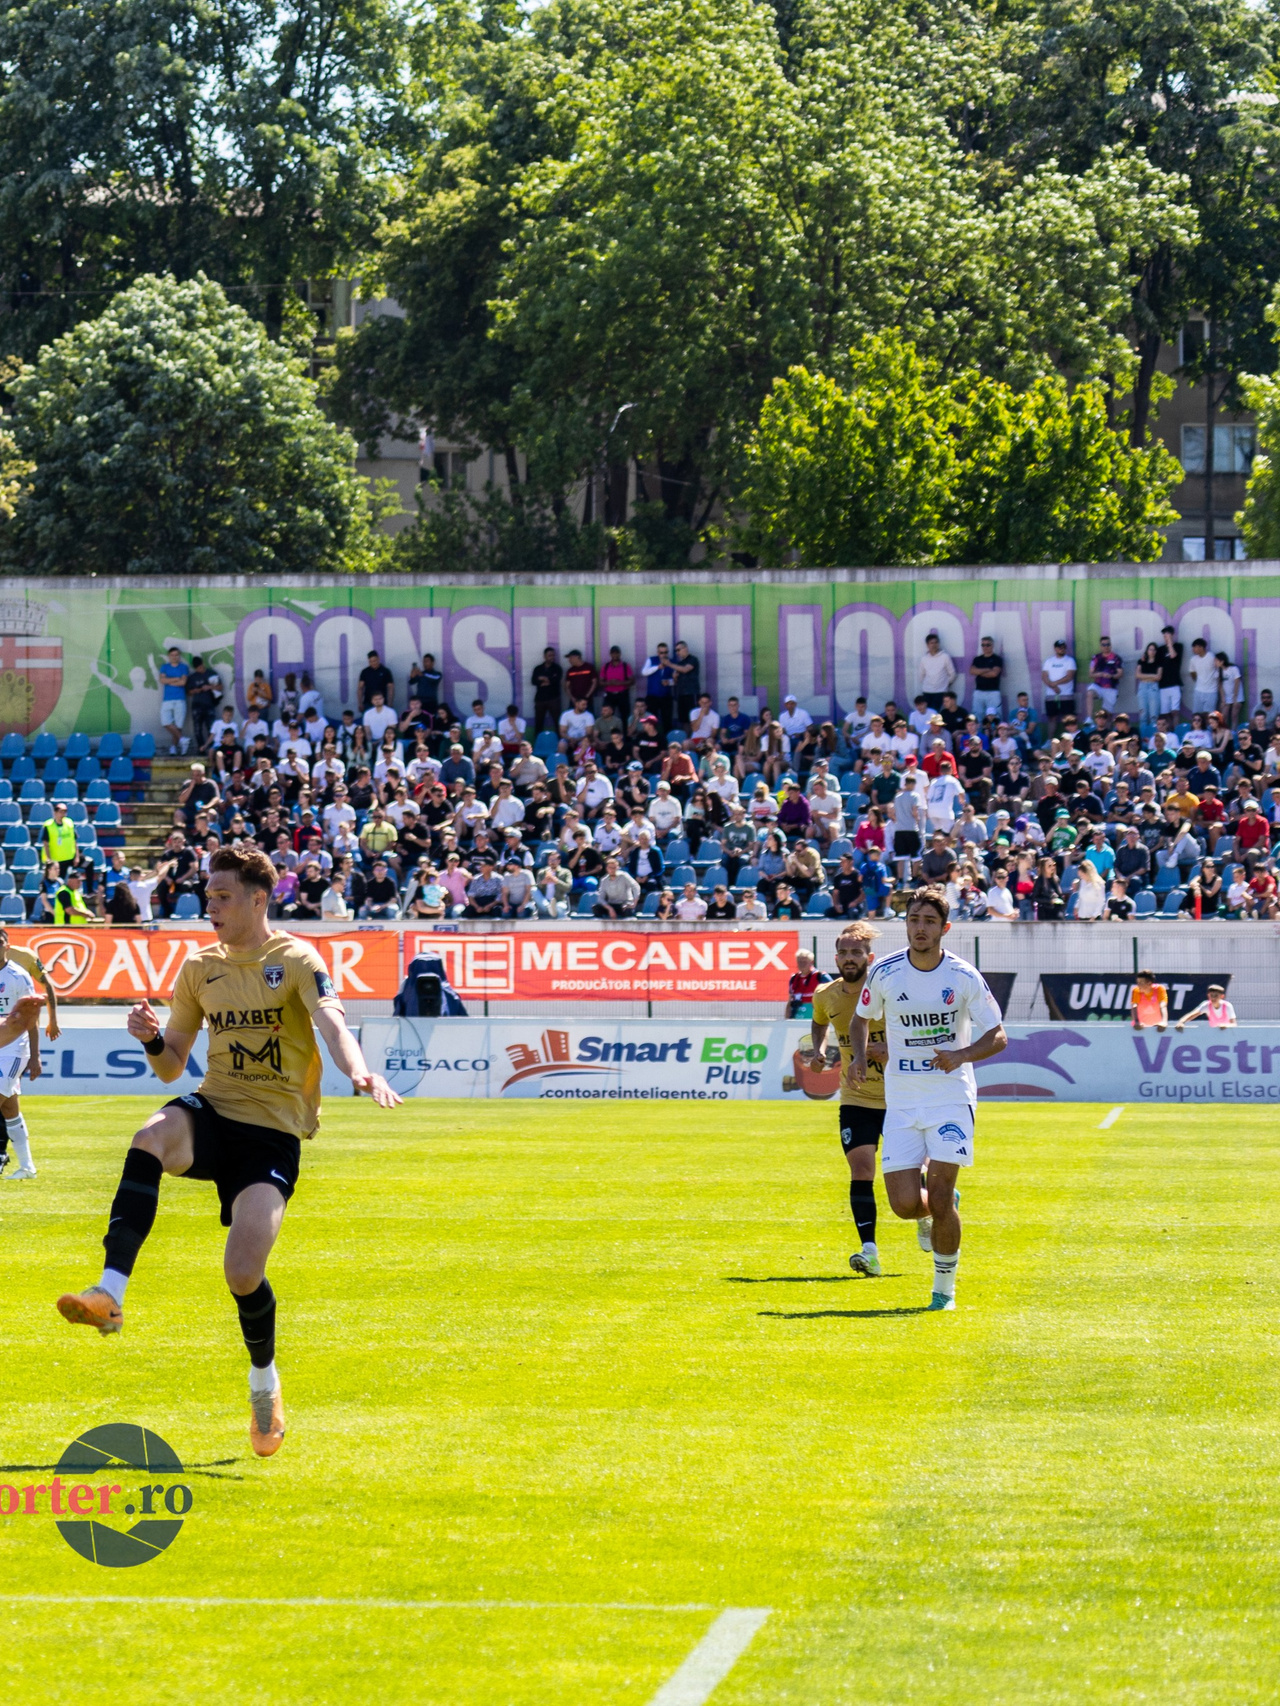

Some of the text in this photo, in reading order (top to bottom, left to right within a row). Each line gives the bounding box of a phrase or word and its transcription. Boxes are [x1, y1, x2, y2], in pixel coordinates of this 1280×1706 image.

[521, 940, 789, 971] MECANEX
[552, 977, 757, 991] PRODUCĂTOR POMPE INDUSTRIALE
[1070, 983, 1195, 1010] UNIT
[209, 1006, 284, 1032] MAXBET
[900, 1010, 959, 1028] UNIBET
[384, 1046, 423, 1060] Grupul
[576, 1036, 768, 1063] Smart Eco
[385, 1058, 490, 1072] ELSACO
[705, 1065, 761, 1085] Plus
[228, 1071, 278, 1081] METROPOLA
[1138, 1080, 1215, 1101] Grupul
